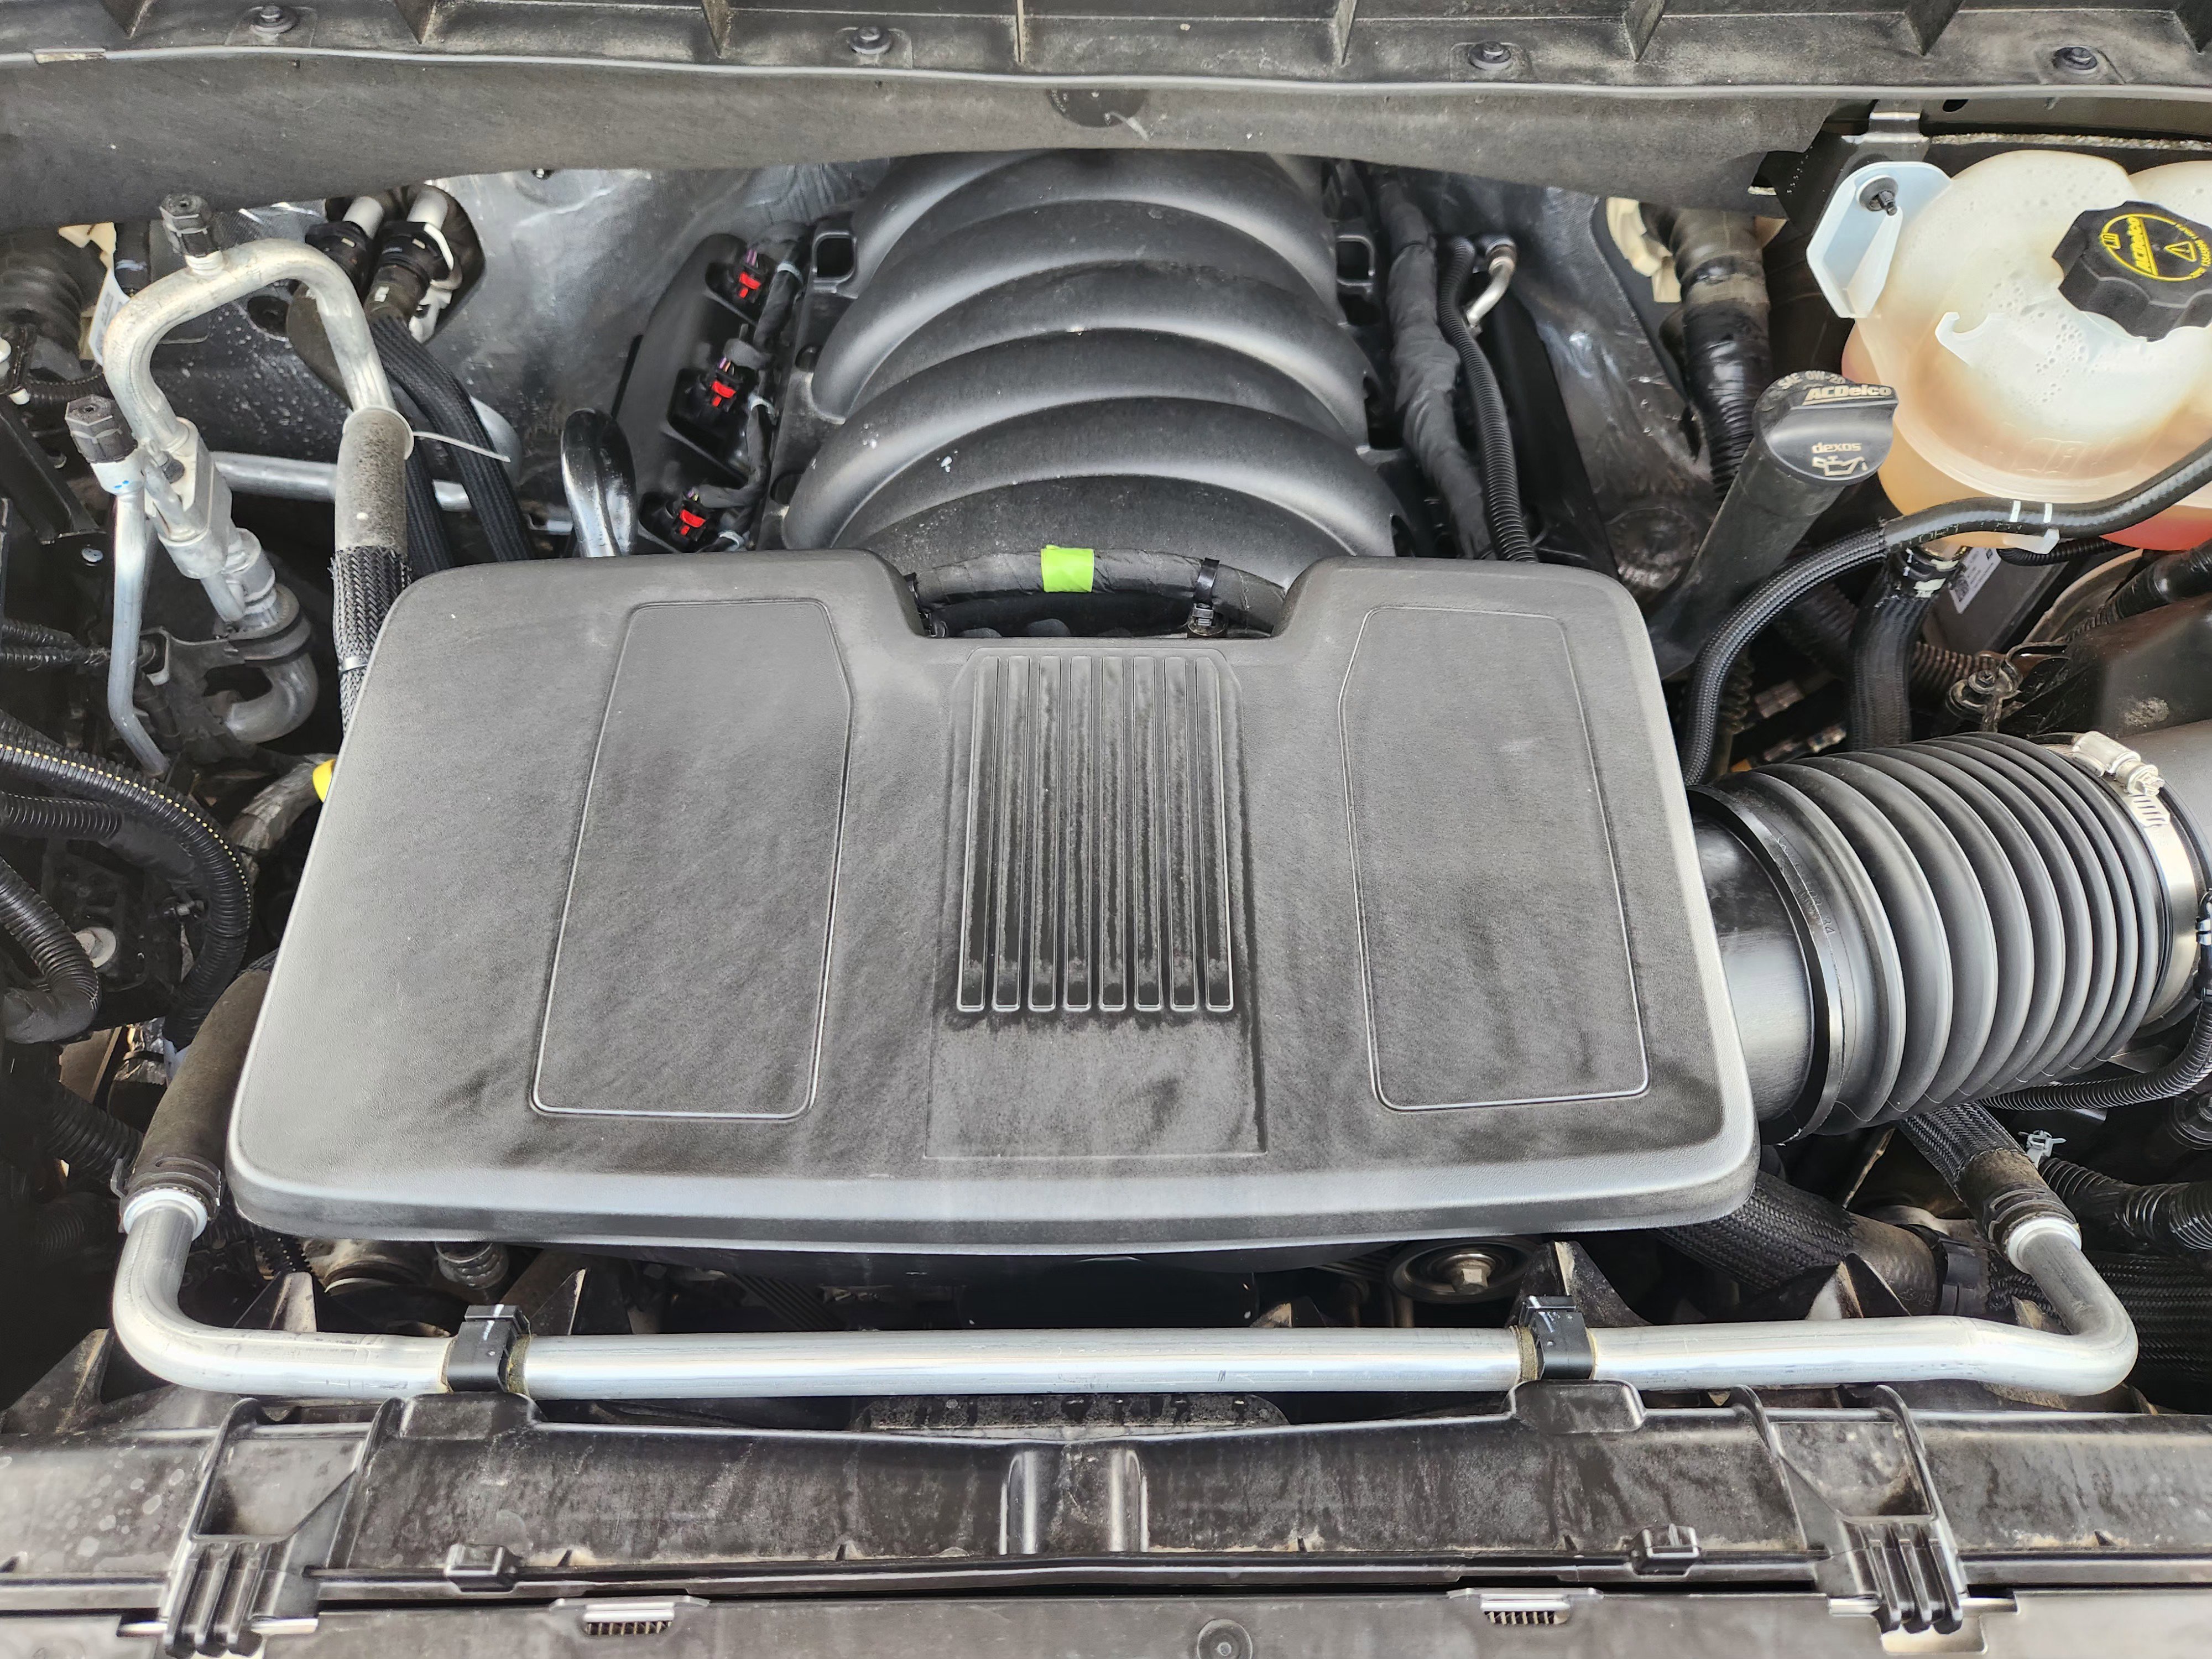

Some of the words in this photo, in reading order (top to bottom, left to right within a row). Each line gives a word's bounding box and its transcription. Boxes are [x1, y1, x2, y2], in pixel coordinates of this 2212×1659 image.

[2127, 217, 2152, 273] ACDelco
[1777, 373, 1802, 389] SAE
[1806, 371, 1845, 384] 0W-20
[1806, 385, 1892, 400] ACDelco
[1812, 442, 1861, 453] dexos
